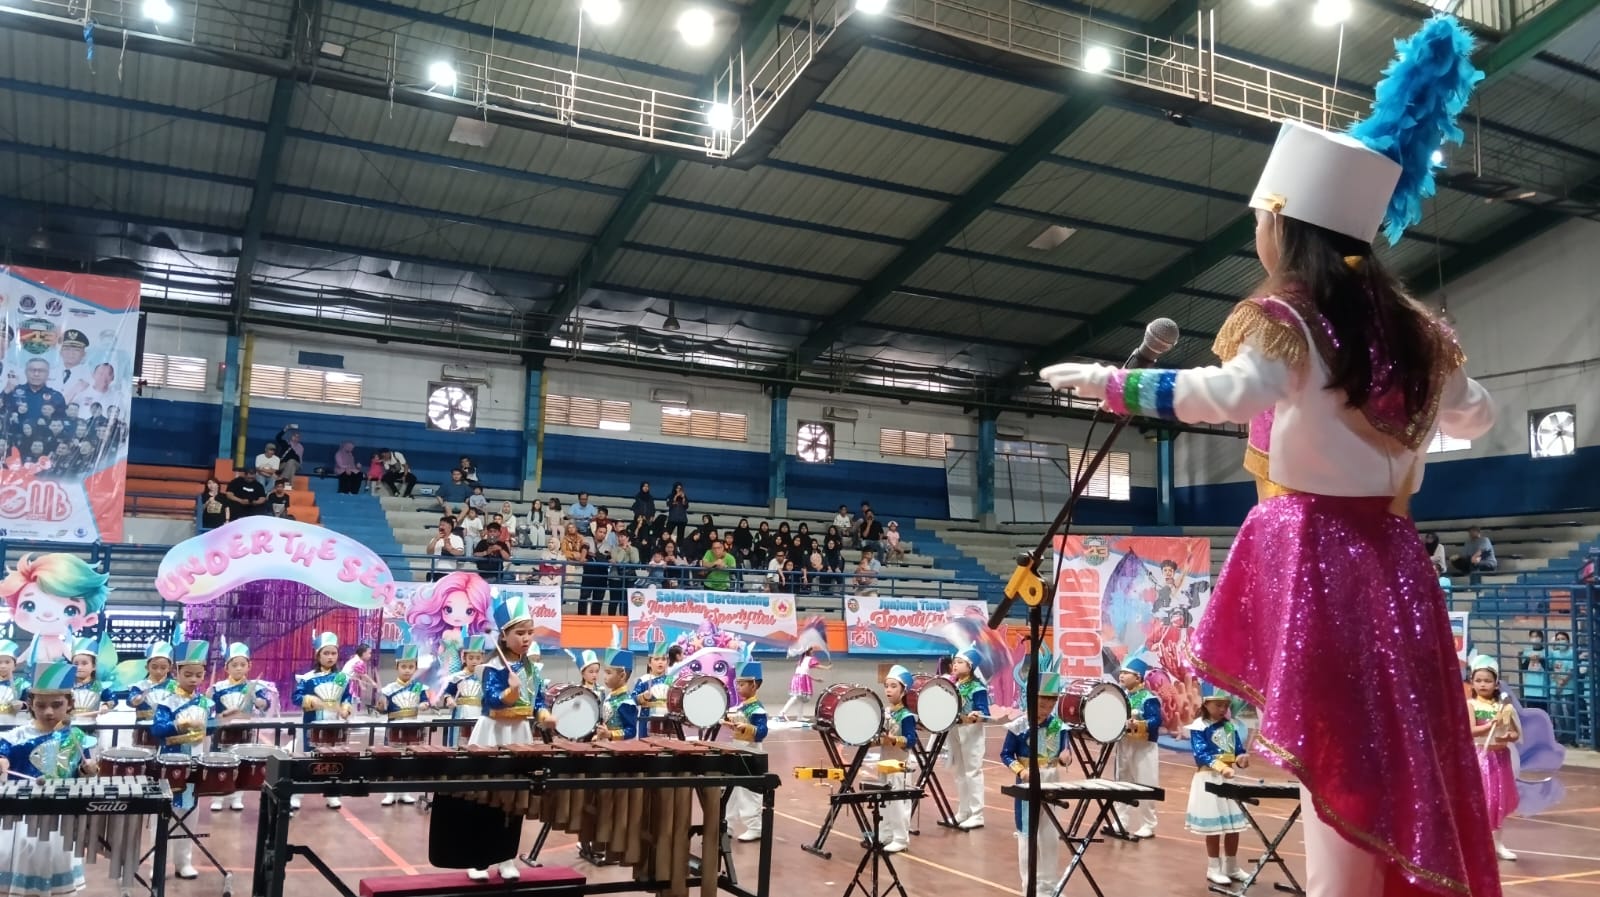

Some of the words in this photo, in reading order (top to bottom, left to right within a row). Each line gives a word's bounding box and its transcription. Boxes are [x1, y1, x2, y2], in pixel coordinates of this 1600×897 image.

[155, 530, 273, 600] UNDER
[280, 531, 337, 567] THE
[337, 556, 395, 604] SEA
[656, 590, 704, 603] Selamat
[706, 592, 770, 607] Bertanding
[879, 599, 918, 611] Junjung
[1059, 568, 1103, 677] FOMB
[86, 800, 128, 812] Saito
